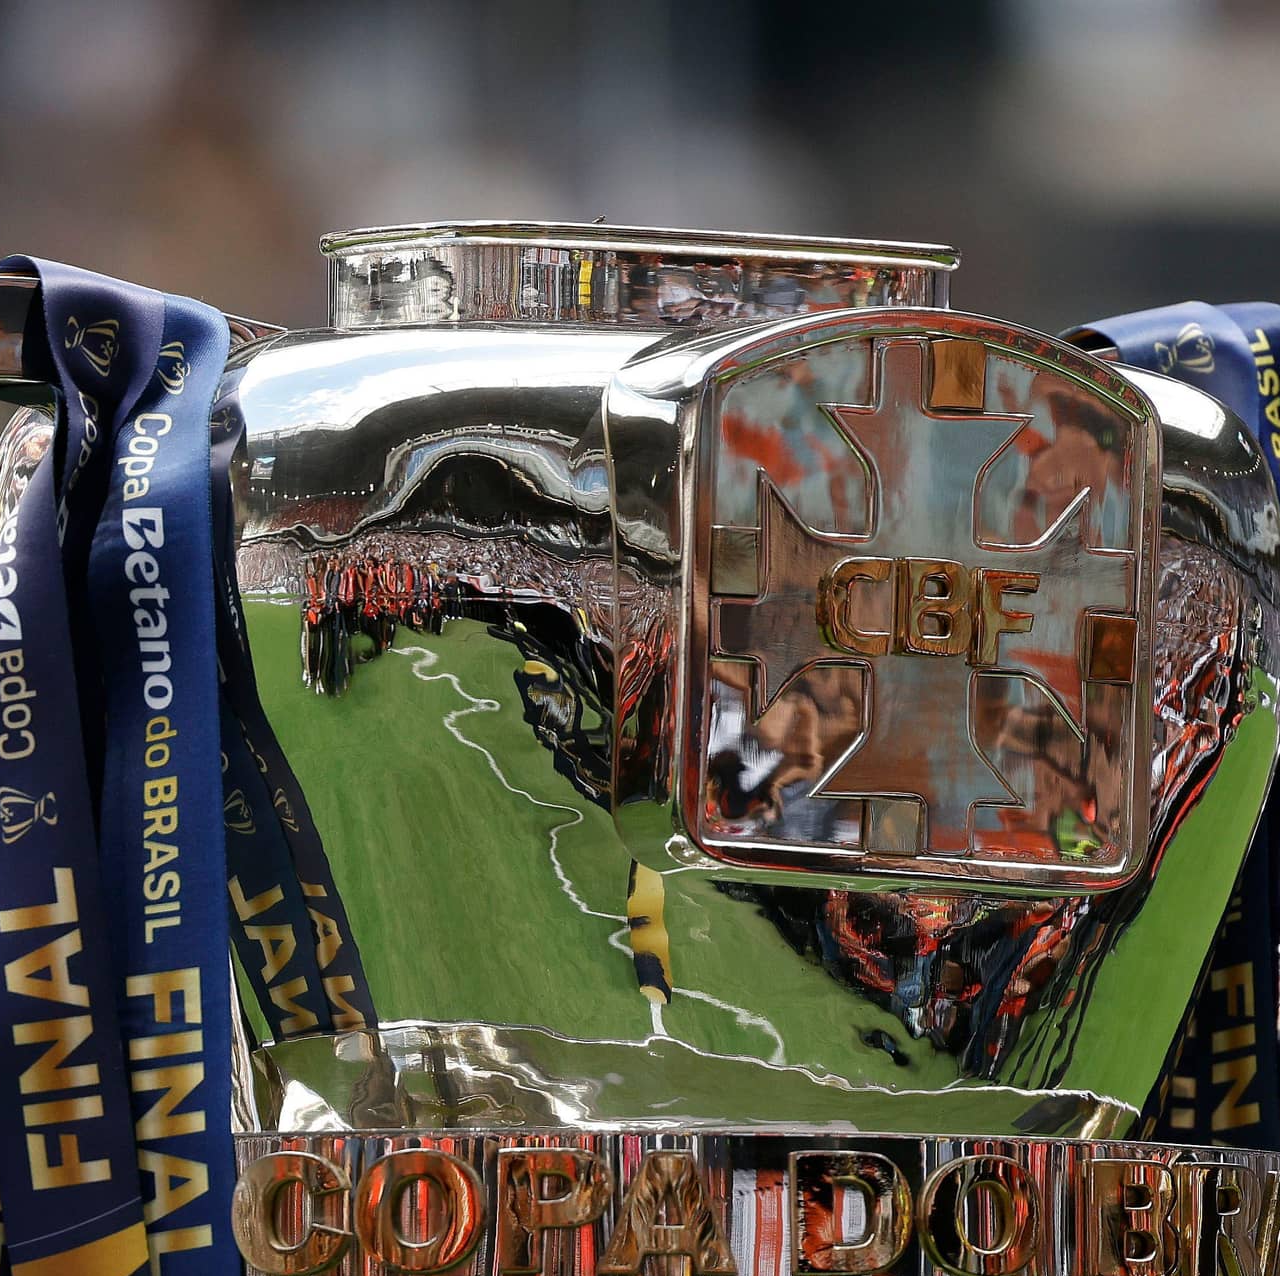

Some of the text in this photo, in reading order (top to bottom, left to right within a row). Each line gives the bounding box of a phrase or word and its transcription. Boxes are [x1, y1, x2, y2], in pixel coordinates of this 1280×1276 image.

[118, 412, 173, 502] Copa
[122, 507, 174, 710] Betano
[817, 556, 1041, 667] CBF
[144, 714, 178, 769] do
[142, 775, 181, 944] BRASIL
[232, 1148, 738, 1276] COPA
